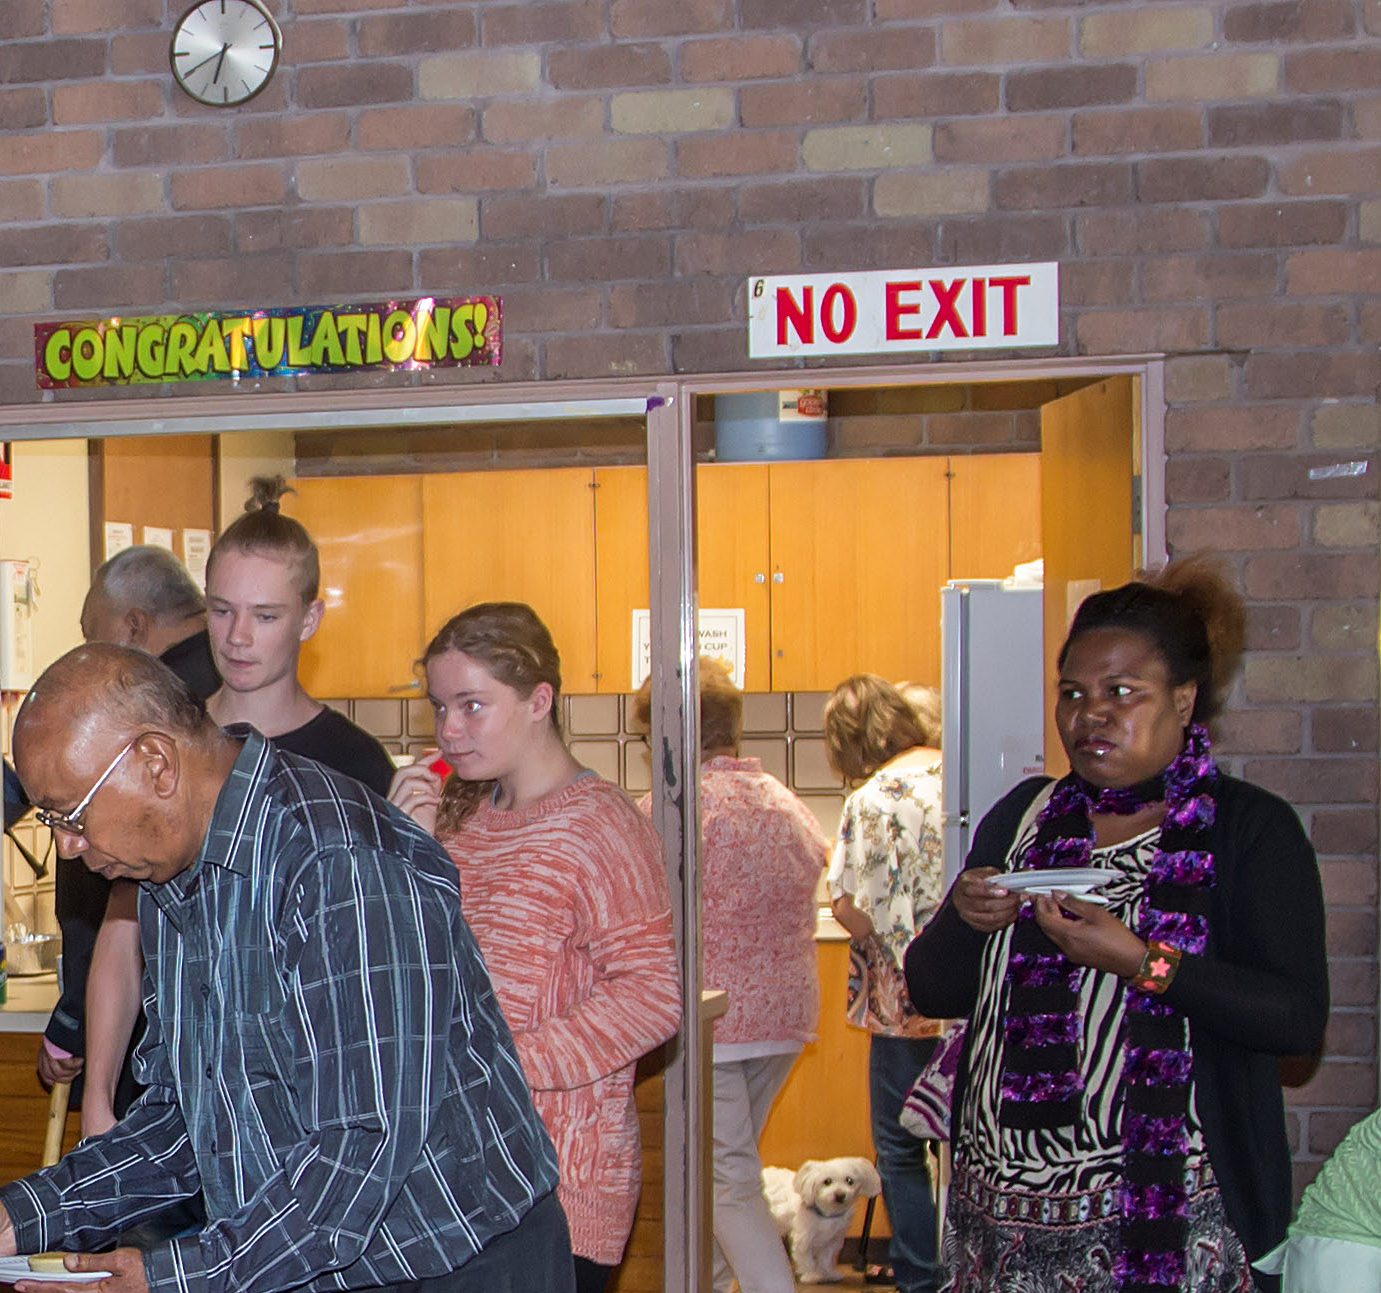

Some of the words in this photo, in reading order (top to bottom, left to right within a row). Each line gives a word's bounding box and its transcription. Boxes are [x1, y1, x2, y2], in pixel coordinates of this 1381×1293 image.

[43, 302, 488, 381] CONGRATULATIONS!
[776, 281, 858, 346] NO
[885, 274, 1031, 341] EXIT
[704, 642, 728, 651] CUP
